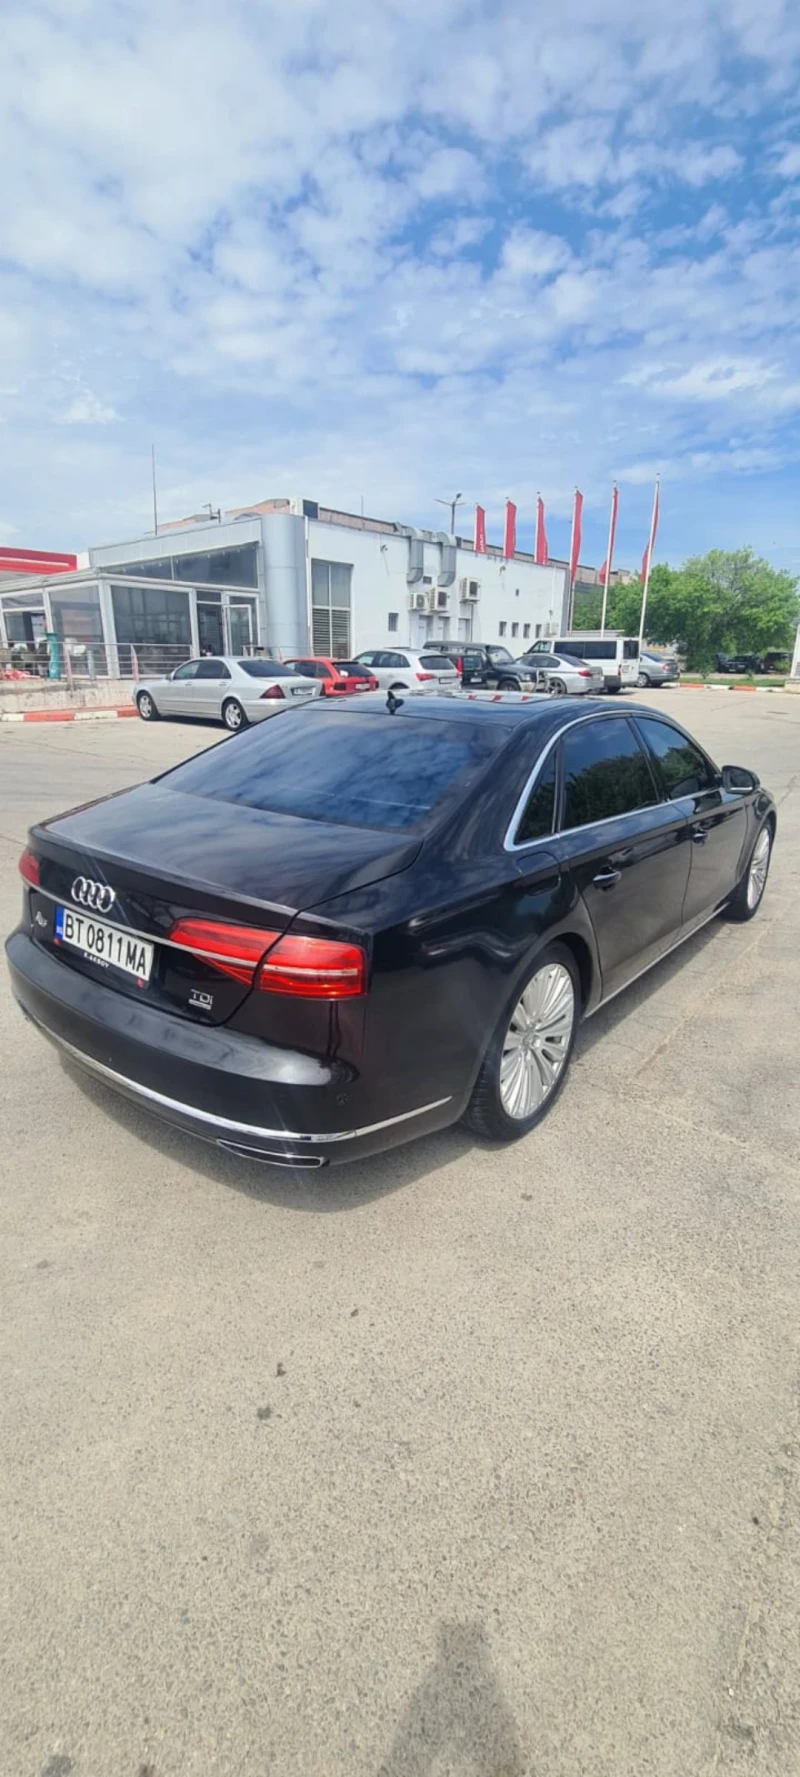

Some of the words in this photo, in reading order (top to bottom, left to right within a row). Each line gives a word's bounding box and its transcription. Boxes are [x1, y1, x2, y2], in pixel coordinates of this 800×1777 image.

[65, 913, 84, 943] BT
[87, 924, 122, 963] 0811
[125, 940, 146, 976] MA
